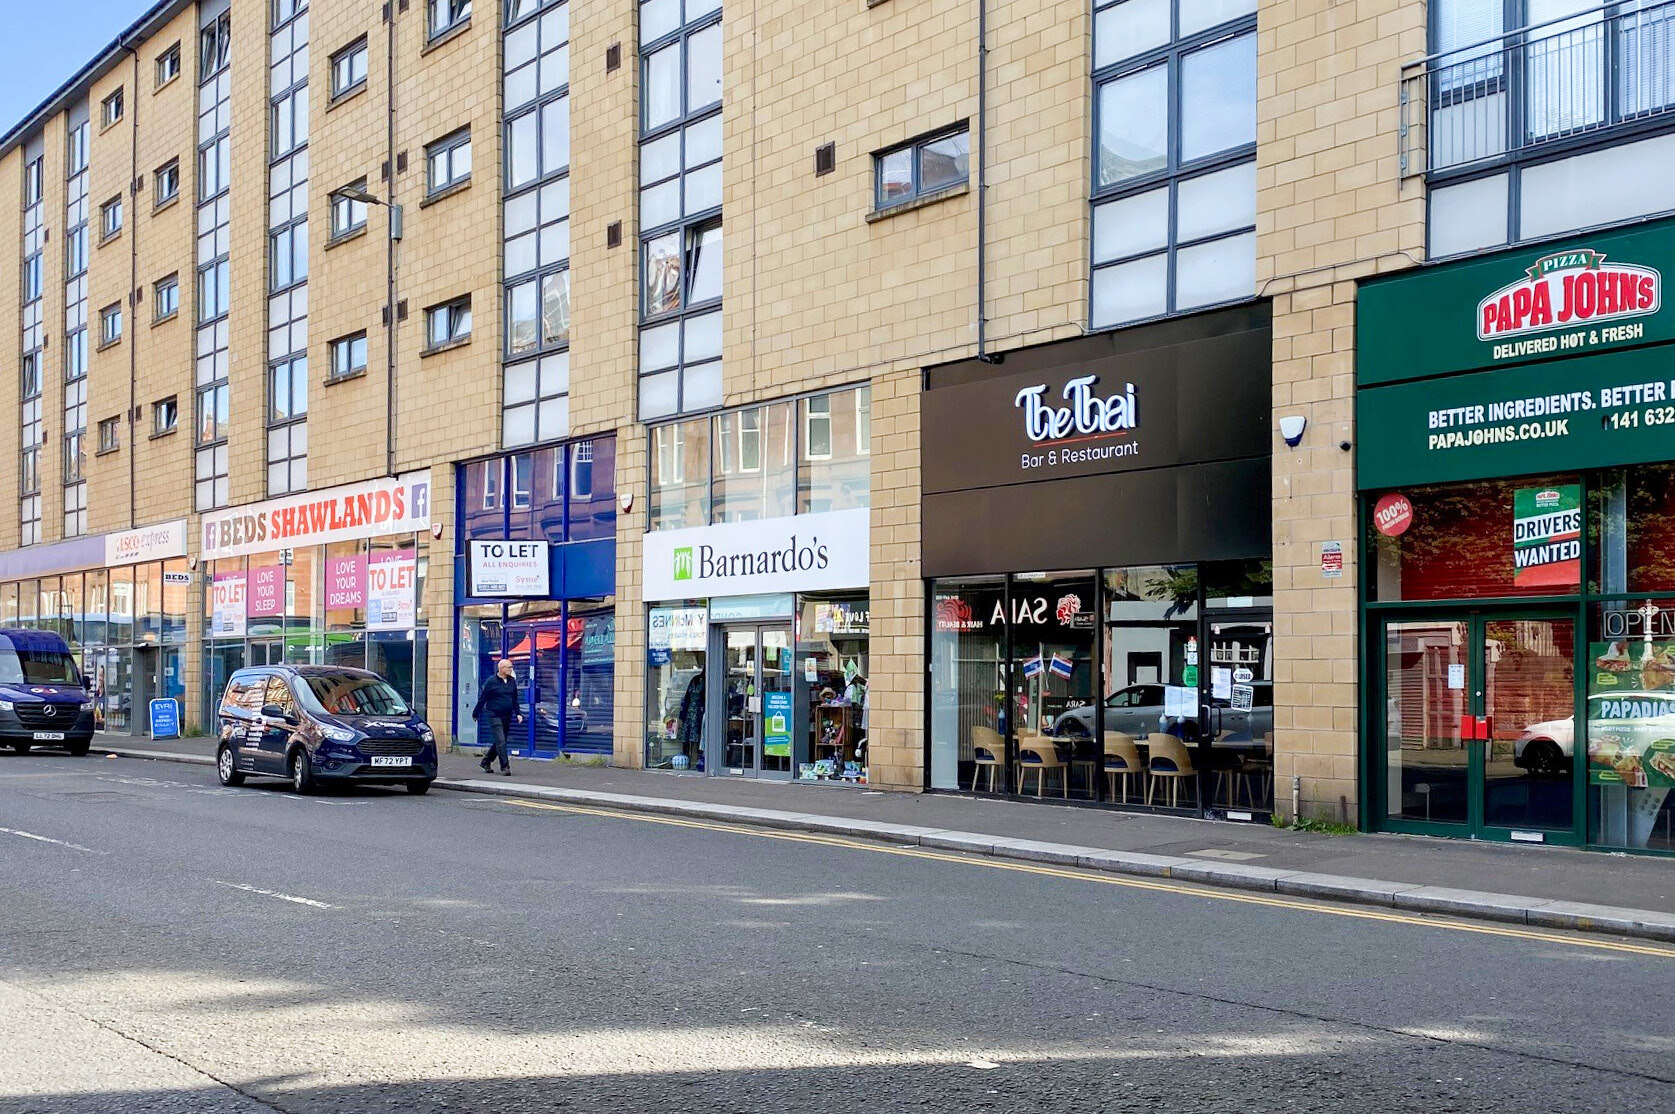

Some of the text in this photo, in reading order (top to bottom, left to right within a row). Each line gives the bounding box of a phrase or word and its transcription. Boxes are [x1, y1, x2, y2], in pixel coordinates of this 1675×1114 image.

[1543, 253, 1587, 271] PIZZA
[1483, 281, 1553, 334] PAPA
[1493, 323, 1643, 359] DELIVERED HOT & FRESH
[1015, 374, 1136, 441] The Thai
[1428, 404, 1484, 429] BETTER
[1488, 391, 1597, 421] INGREDIENTS.
[1600, 381, 1666, 408] BETTER
[1428, 406, 1675, 450] PAPAJOHNS.CO.UK 141 632
[1021, 440, 1139, 469] Bar & Restaurant
[220, 512, 266, 548] BEDS
[271, 486, 405, 540] SHAWLANDS
[1377, 499, 1408, 524] 100%
[1515, 513, 1580, 540] DRIVERS
[480, 544, 538, 558] TO LET
[1514, 540, 1580, 568] WANTED
[165, 573, 189, 581] BEDS
[256, 571, 274, 584] LOVE
[336, 560, 356, 575] LOVE
[370, 565, 414, 591] TO LET
[214, 583, 246, 604] TO LET
[256, 584, 275, 597] YOUR
[335, 575, 357, 590] YOUR
[255, 598, 276, 612] SLEEP
[330, 591, 362, 605] DREAMS
[1607, 611, 1675, 635] OPEN
